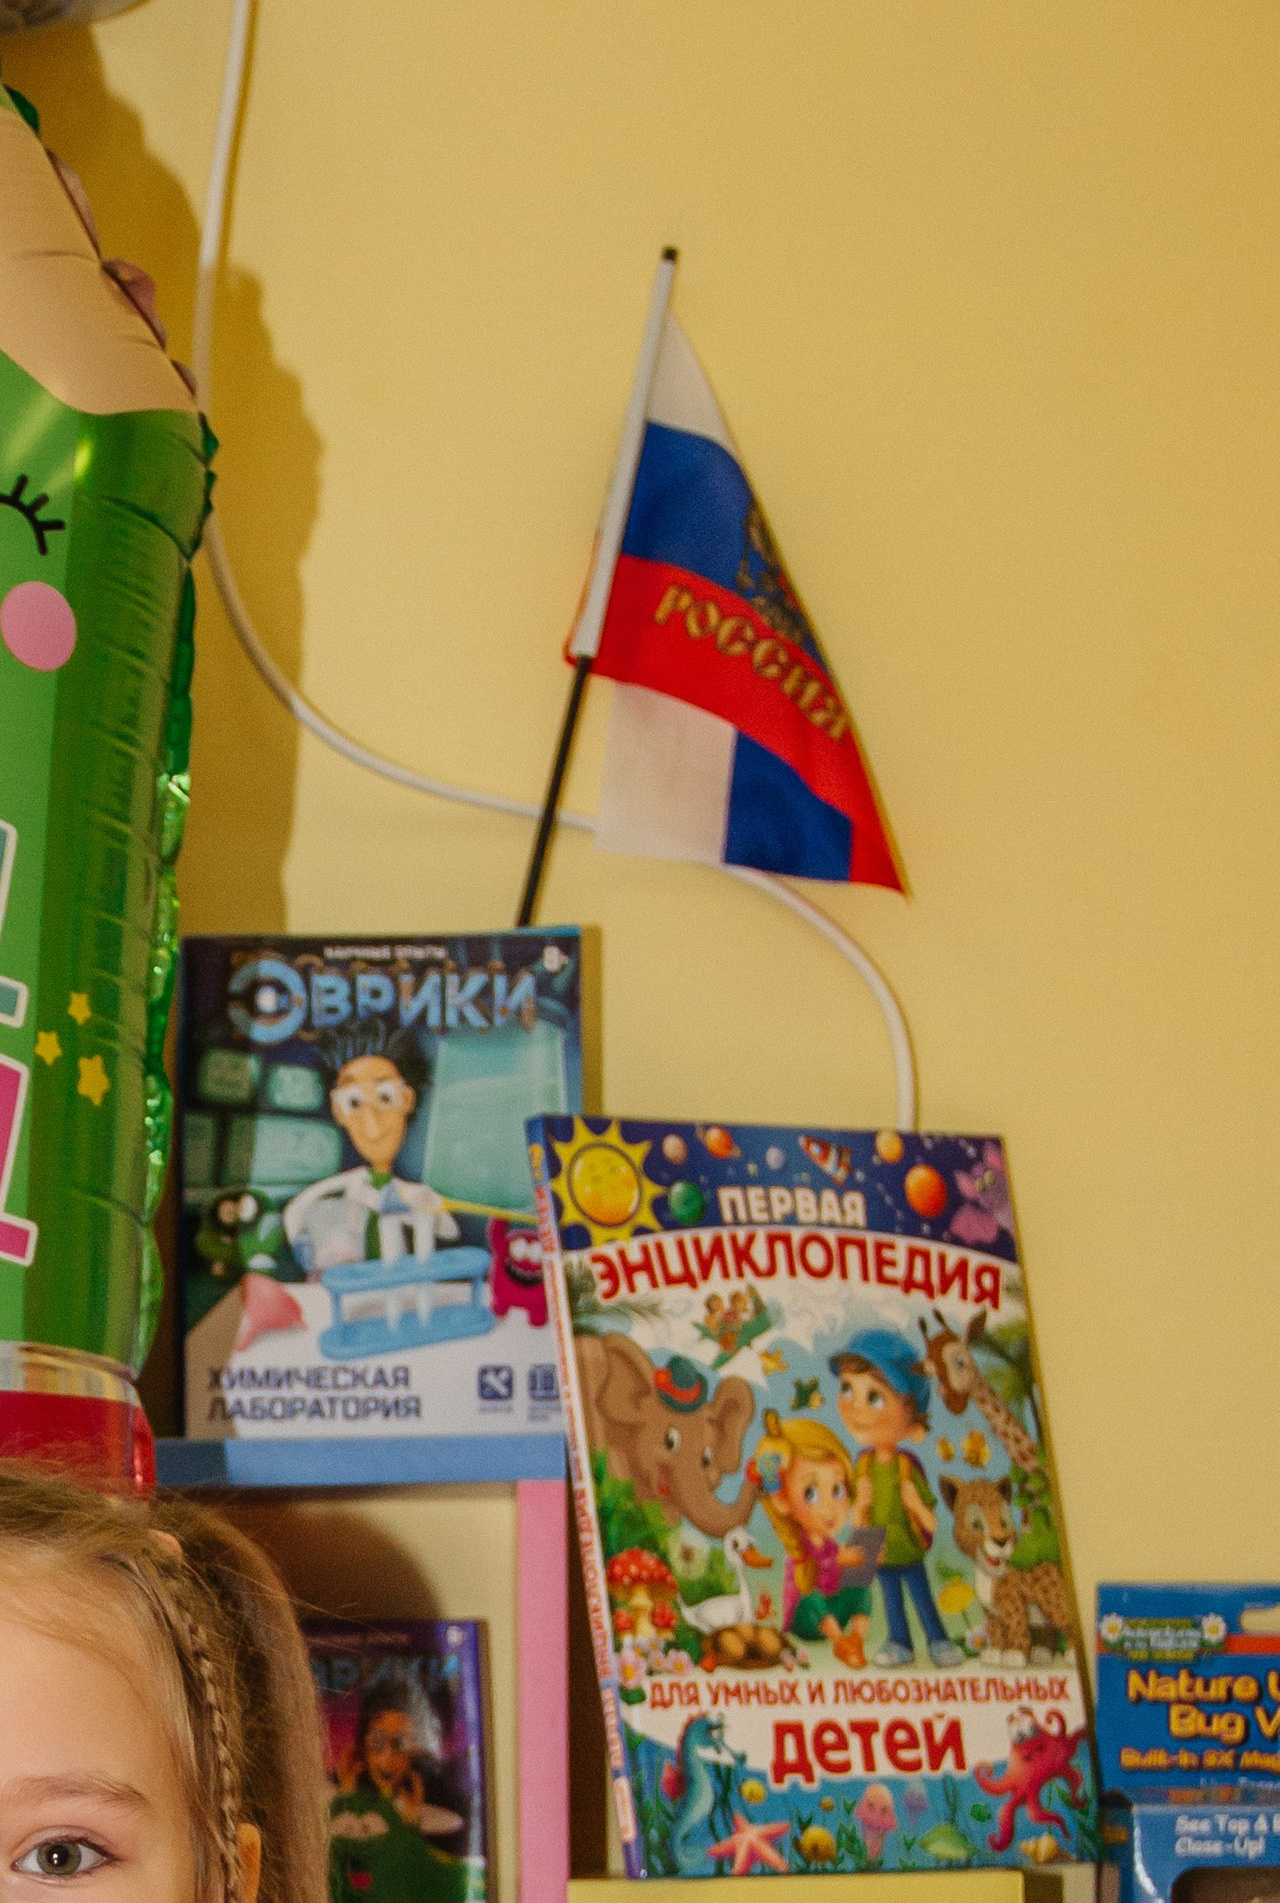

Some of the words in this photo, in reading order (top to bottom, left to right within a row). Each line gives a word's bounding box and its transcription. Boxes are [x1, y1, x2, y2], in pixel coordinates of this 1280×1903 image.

[654, 582, 851, 745] РОССИЯ
[228, 958, 536, 1043] ЭВРИКИ
[718, 1185, 868, 1228] ПЕРВАЯ
[591, 1230, 1002, 1311] ЭНЦИКЛОПЕДИЯ
[208, 1365, 411, 1391] ХИМИЧЕСКАЯ
[208, 1396, 422, 1421] ЛАБОРАТОРИЯ
[649, 1681, 701, 1709] ДЛЯ
[706, 1679, 802, 1707] УМНЫХ
[806, 1679, 824, 1703] И
[832, 1676, 1070, 1704] ЛЮБОЗНАТЕЛЬНЫХ
[1126, 1668, 1260, 1703] Nature
[1169, 1703, 1247, 1745] Bug
[1214, 1813, 1251, 1837] Top
